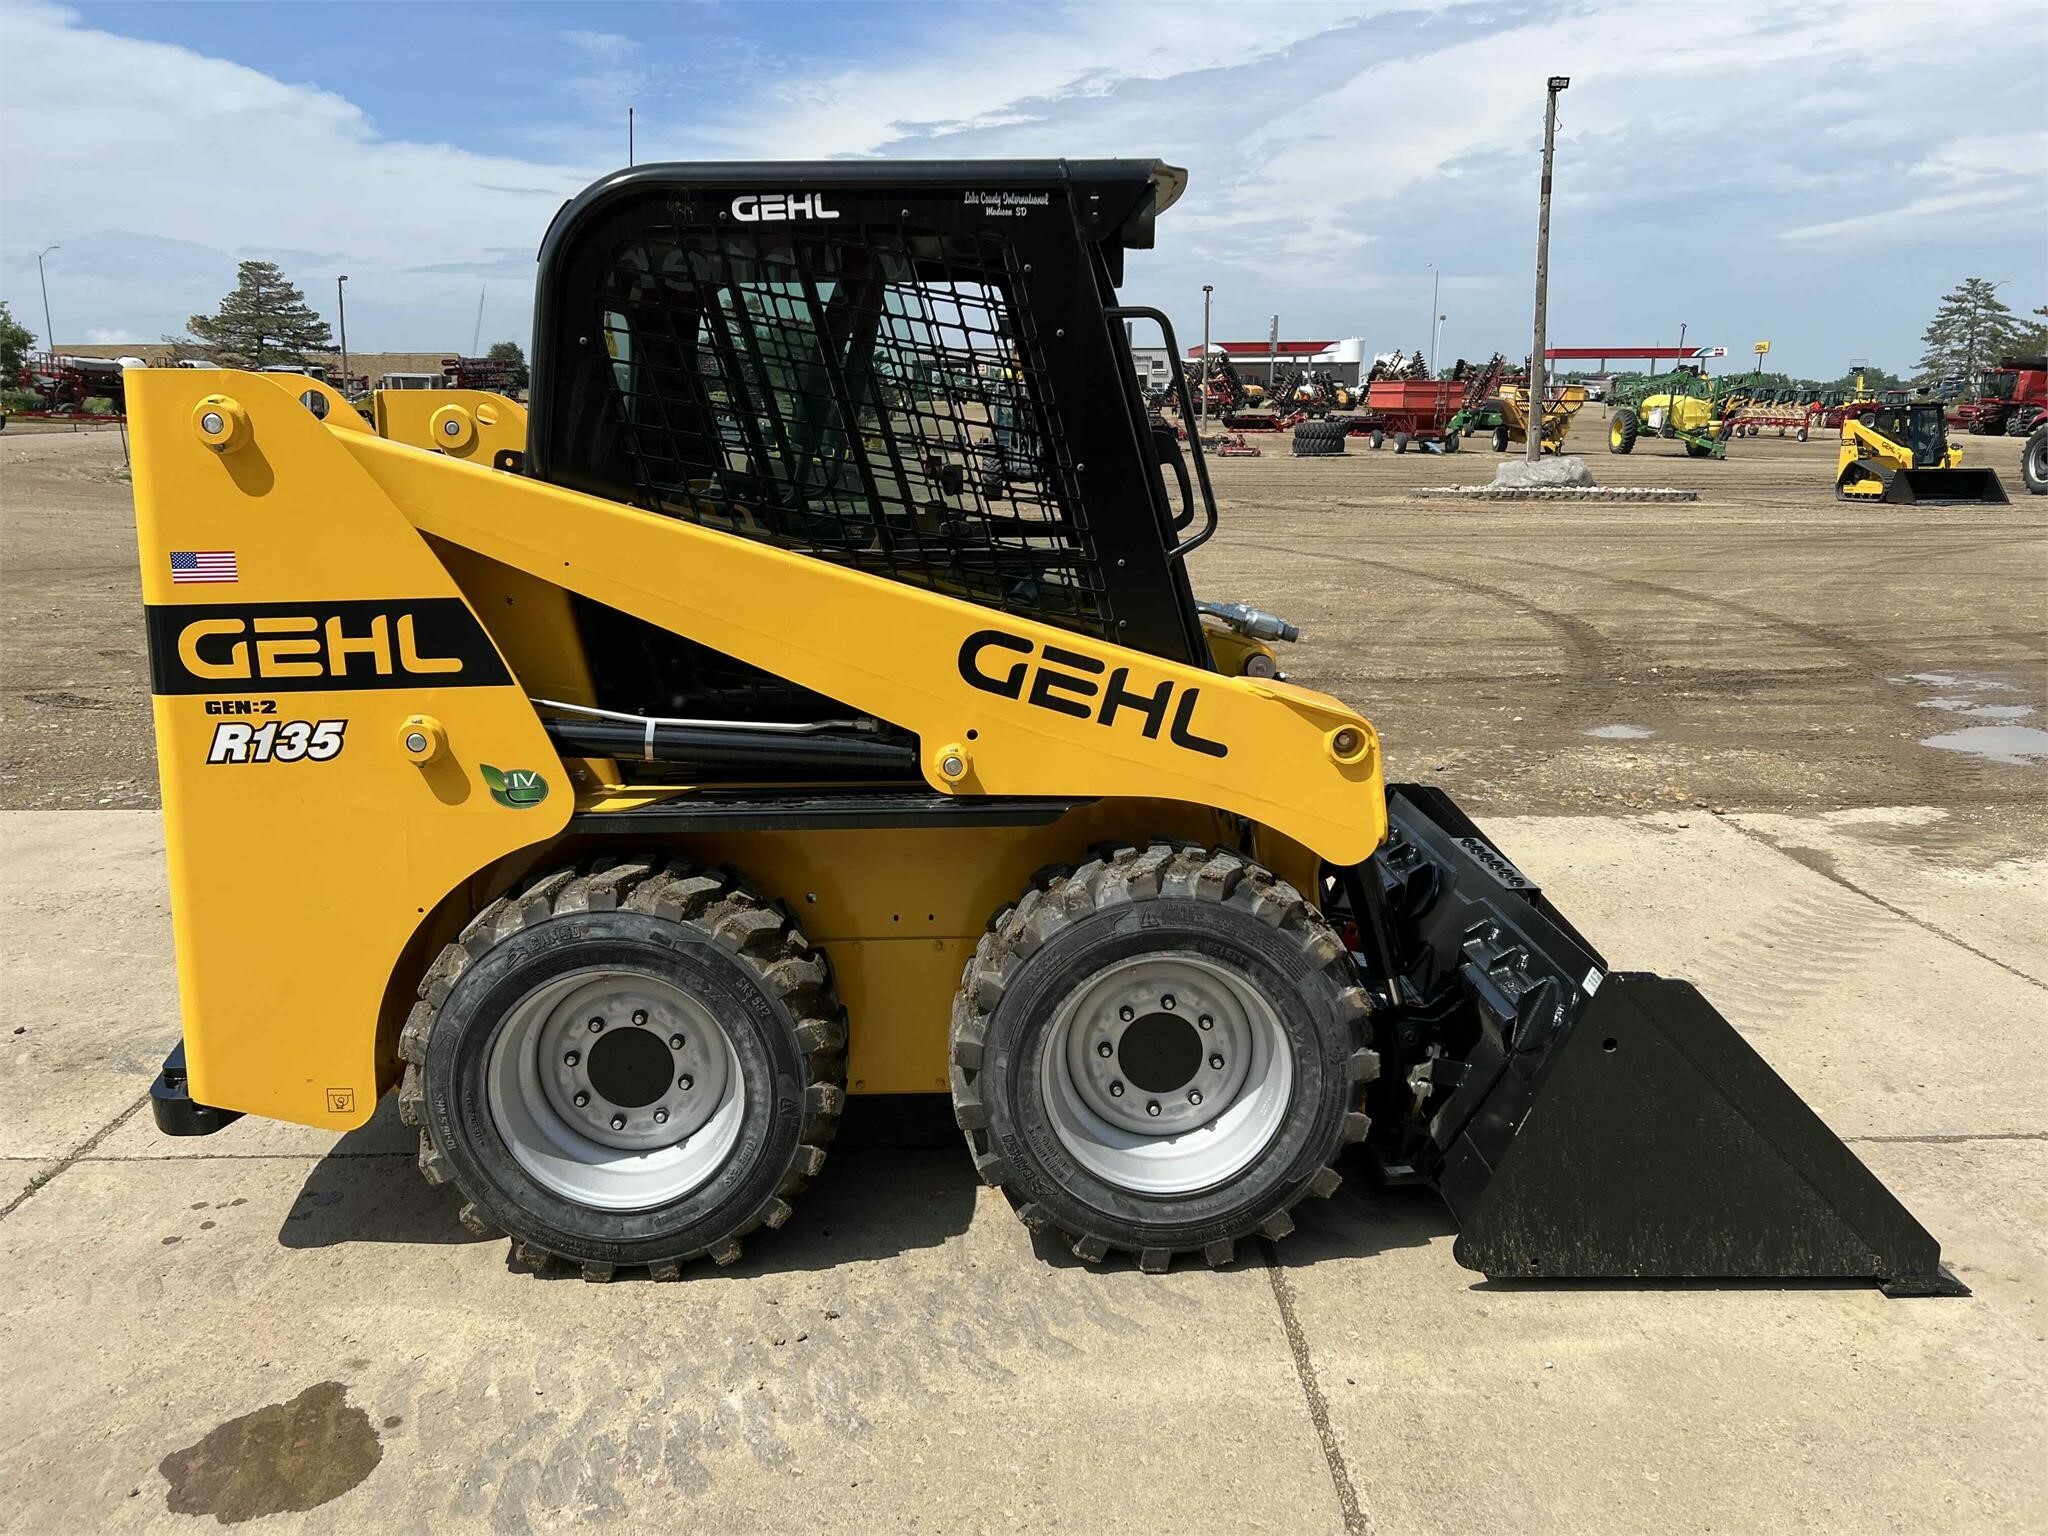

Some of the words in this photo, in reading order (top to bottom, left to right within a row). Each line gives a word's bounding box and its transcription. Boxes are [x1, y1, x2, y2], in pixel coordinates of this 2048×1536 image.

[731, 193, 840, 222] GEHL
[964, 191, 979, 204] Lake
[980, 191, 1001, 207] County
[1002, 191, 1049, 206] International
[1015, 207, 1027, 216] SD
[1881, 441, 1895, 454] GEHL
[177, 614, 463, 680] GEHL
[958, 629, 1228, 759] GEHL
[205, 700, 277, 715] GEN:2
[206, 719, 349, 765] R135
[513, 771, 537, 788] IV
